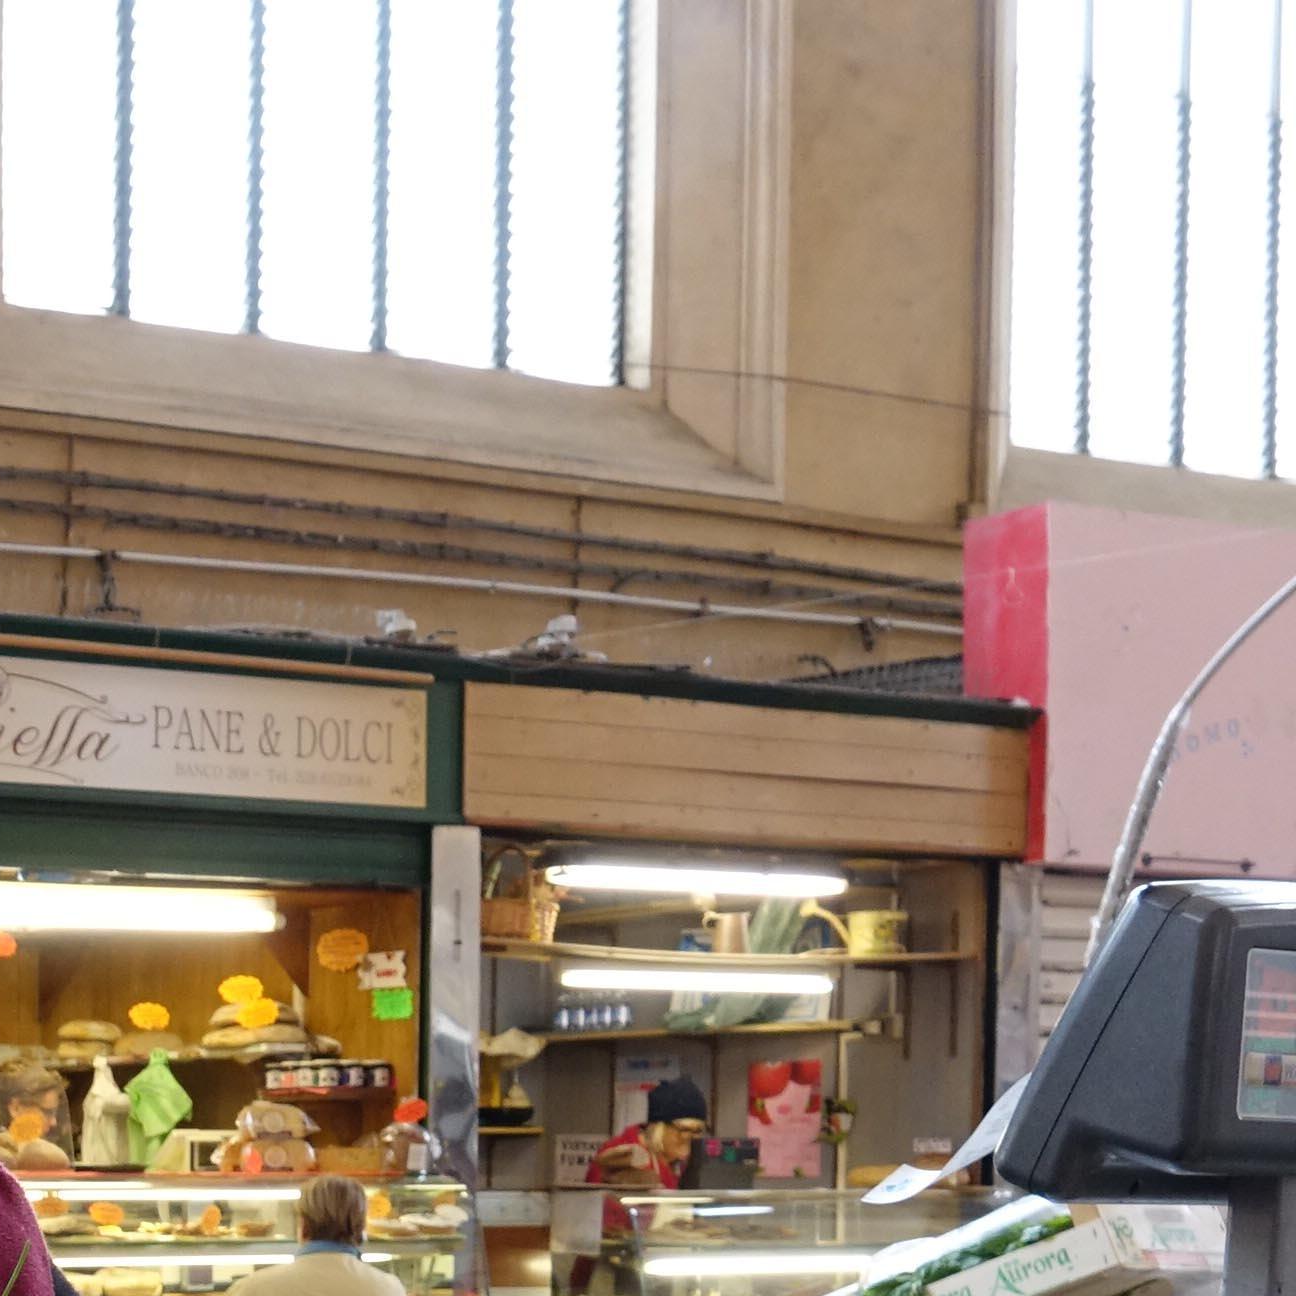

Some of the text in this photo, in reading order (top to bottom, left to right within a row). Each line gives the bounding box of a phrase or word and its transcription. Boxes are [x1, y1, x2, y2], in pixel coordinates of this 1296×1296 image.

[152, 704, 394, 766] PANE & DOLCI
